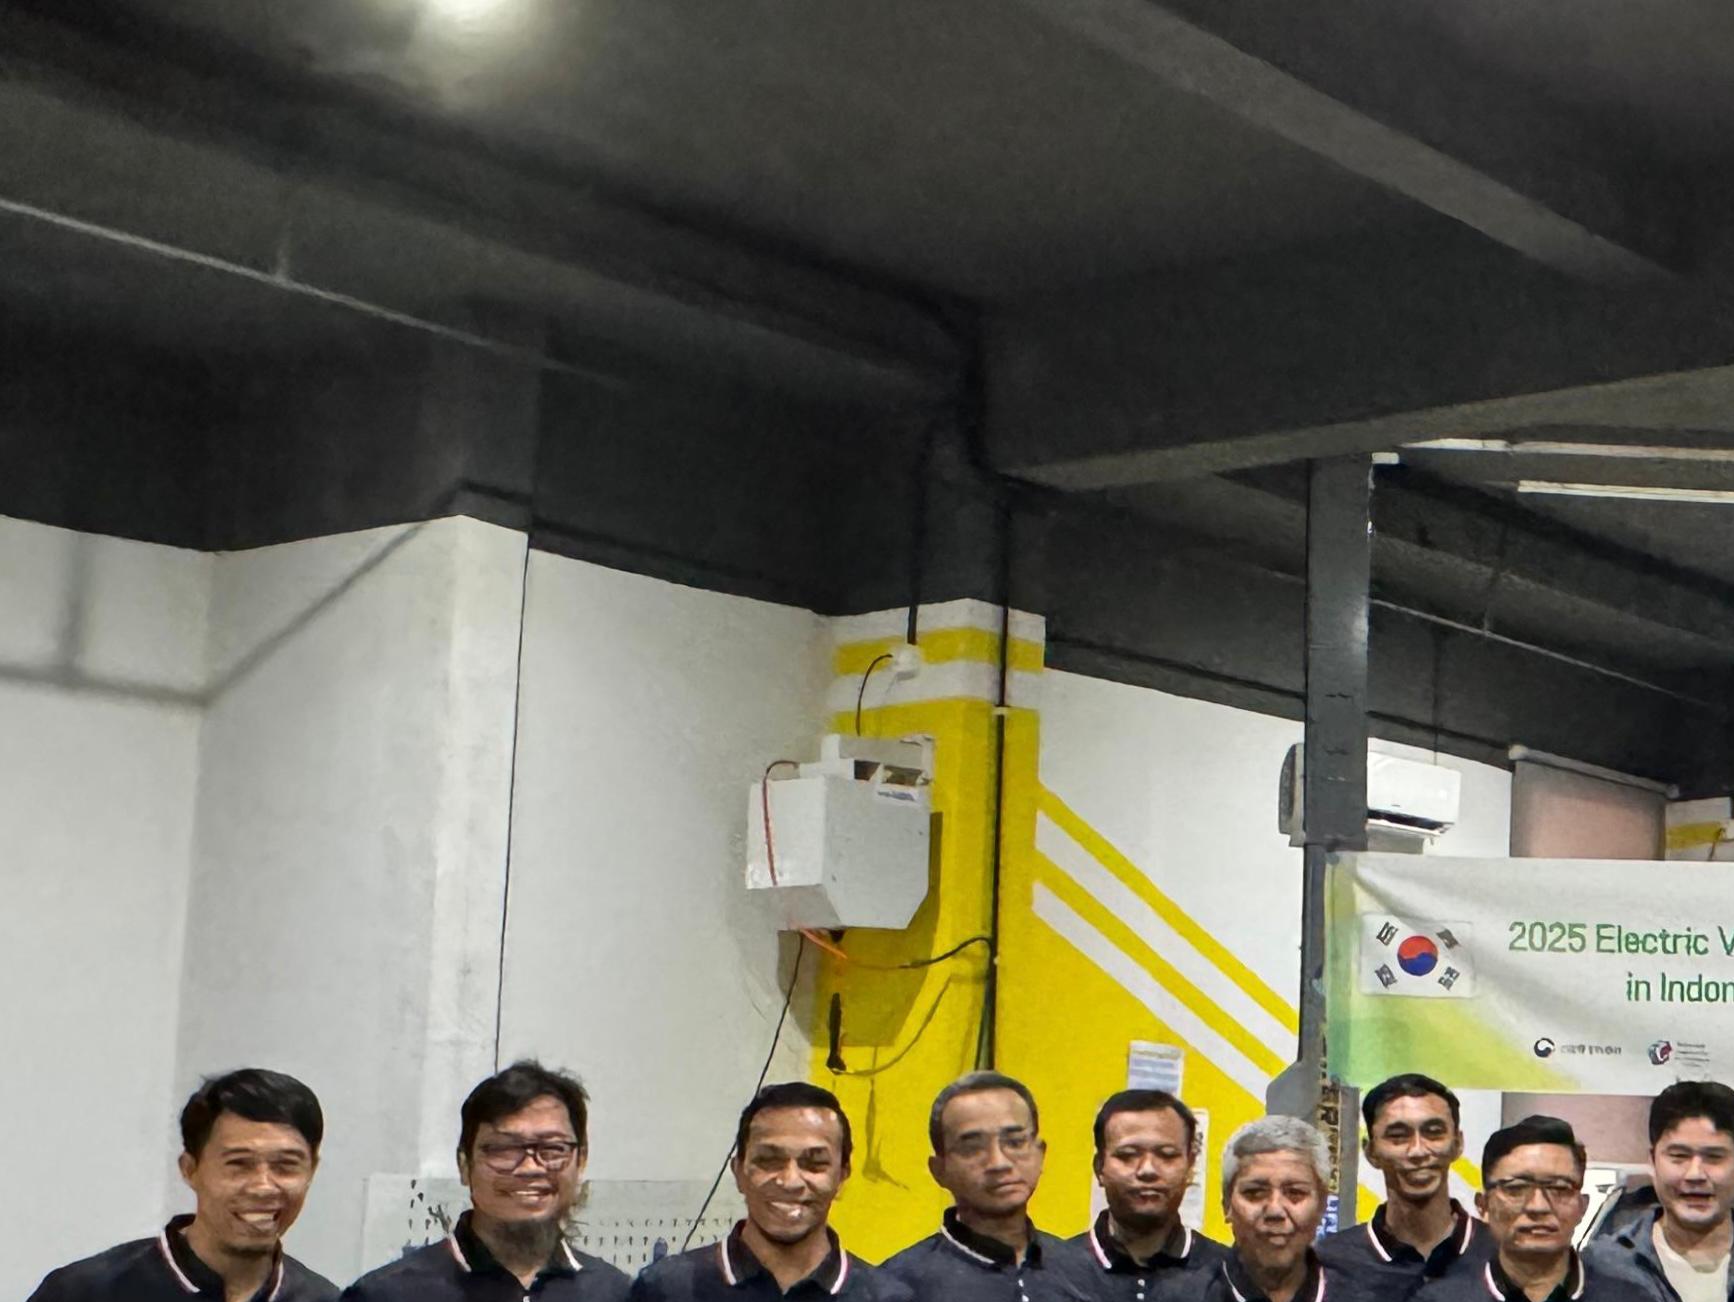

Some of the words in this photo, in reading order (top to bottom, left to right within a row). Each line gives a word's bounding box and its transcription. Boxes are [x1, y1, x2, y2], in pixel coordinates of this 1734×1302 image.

[1508, 921, 1587, 953] 2025
[1595, 923, 1709, 956] Electric
[1626, 971, 1651, 1002] in
